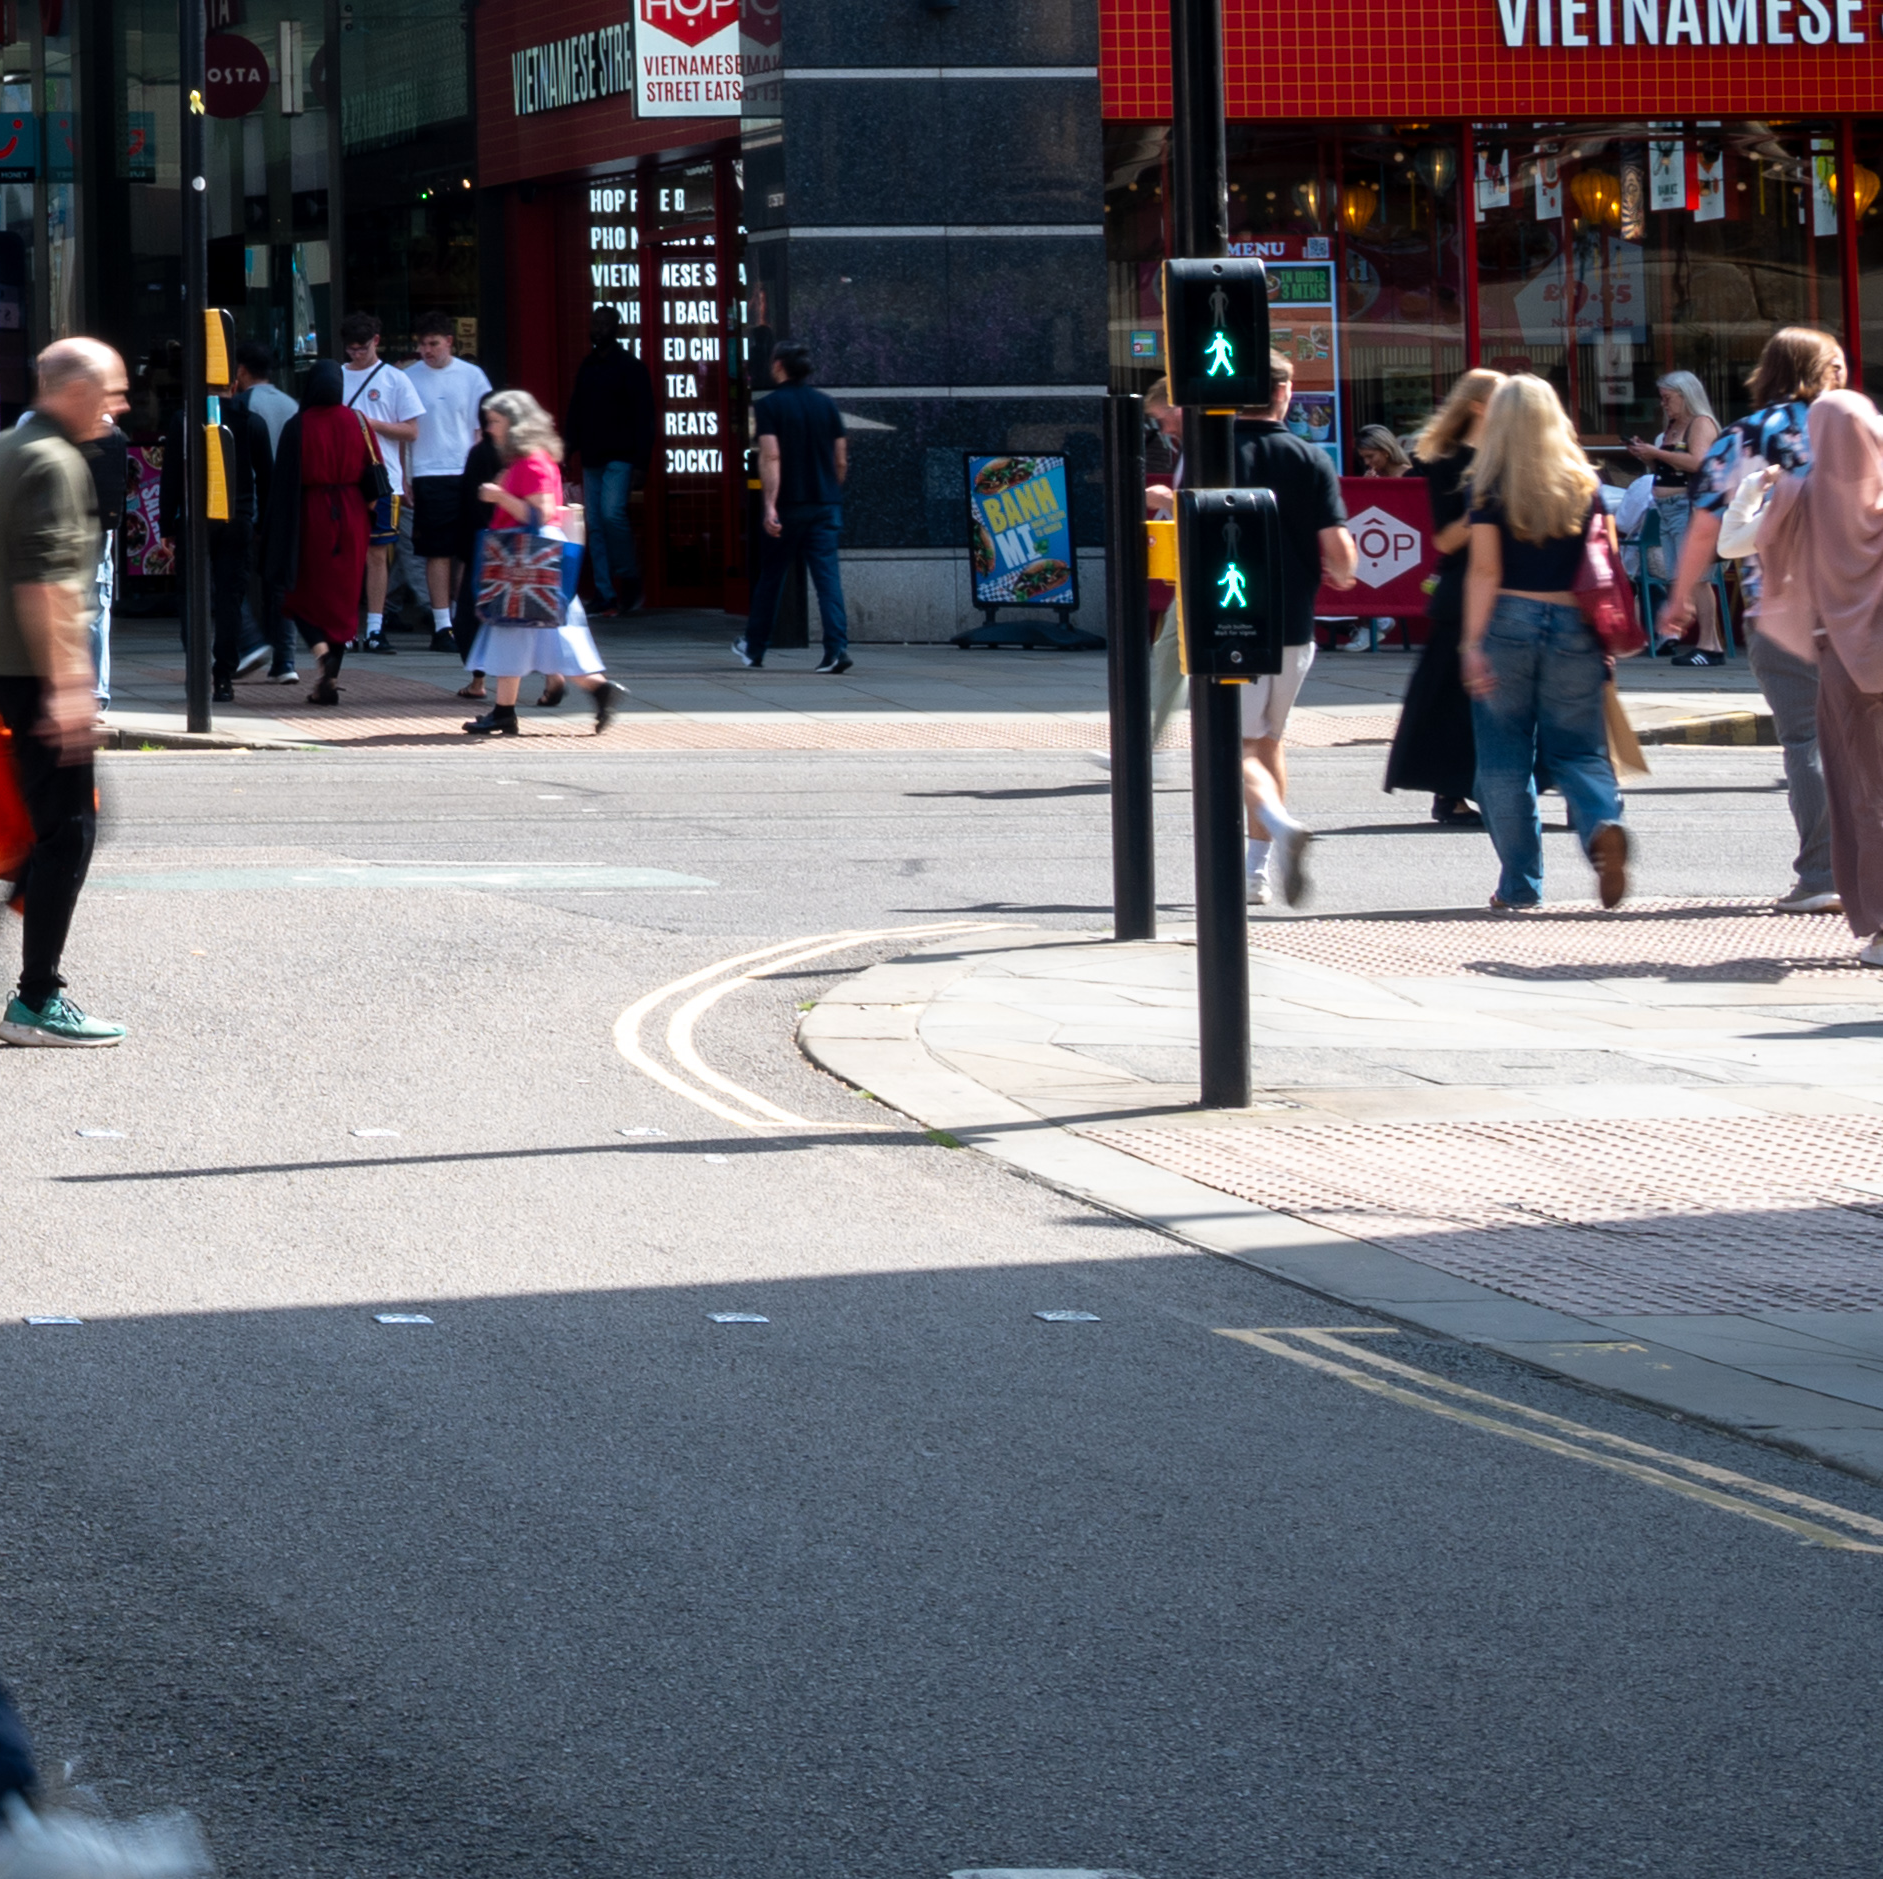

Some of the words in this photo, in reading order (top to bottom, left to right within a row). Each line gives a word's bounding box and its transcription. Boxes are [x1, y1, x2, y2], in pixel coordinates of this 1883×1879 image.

[206, 67, 262, 85] OSTA
[511, 32, 596, 116] VIETNAMESE
[599, 22, 633, 97] STRE
[643, 55, 741, 77] VIETNAMESE
[647, 81, 699, 102] STREET
[705, 80, 741, 102] EATS
[0, 171, 28, 180] MONEY
[589, 188, 626, 212] HOP
[590, 226, 627, 250] PHO
[1227, 242, 1286, 257] MENU
[1281, 283, 1290, 299] 3
[1292, 283, 1327, 300] MINS
[666, 374, 697, 398] TEA
[665, 412, 718, 436] REATS
[983, 476, 1059, 533] BANH
[995, 523, 1042, 570] MI
